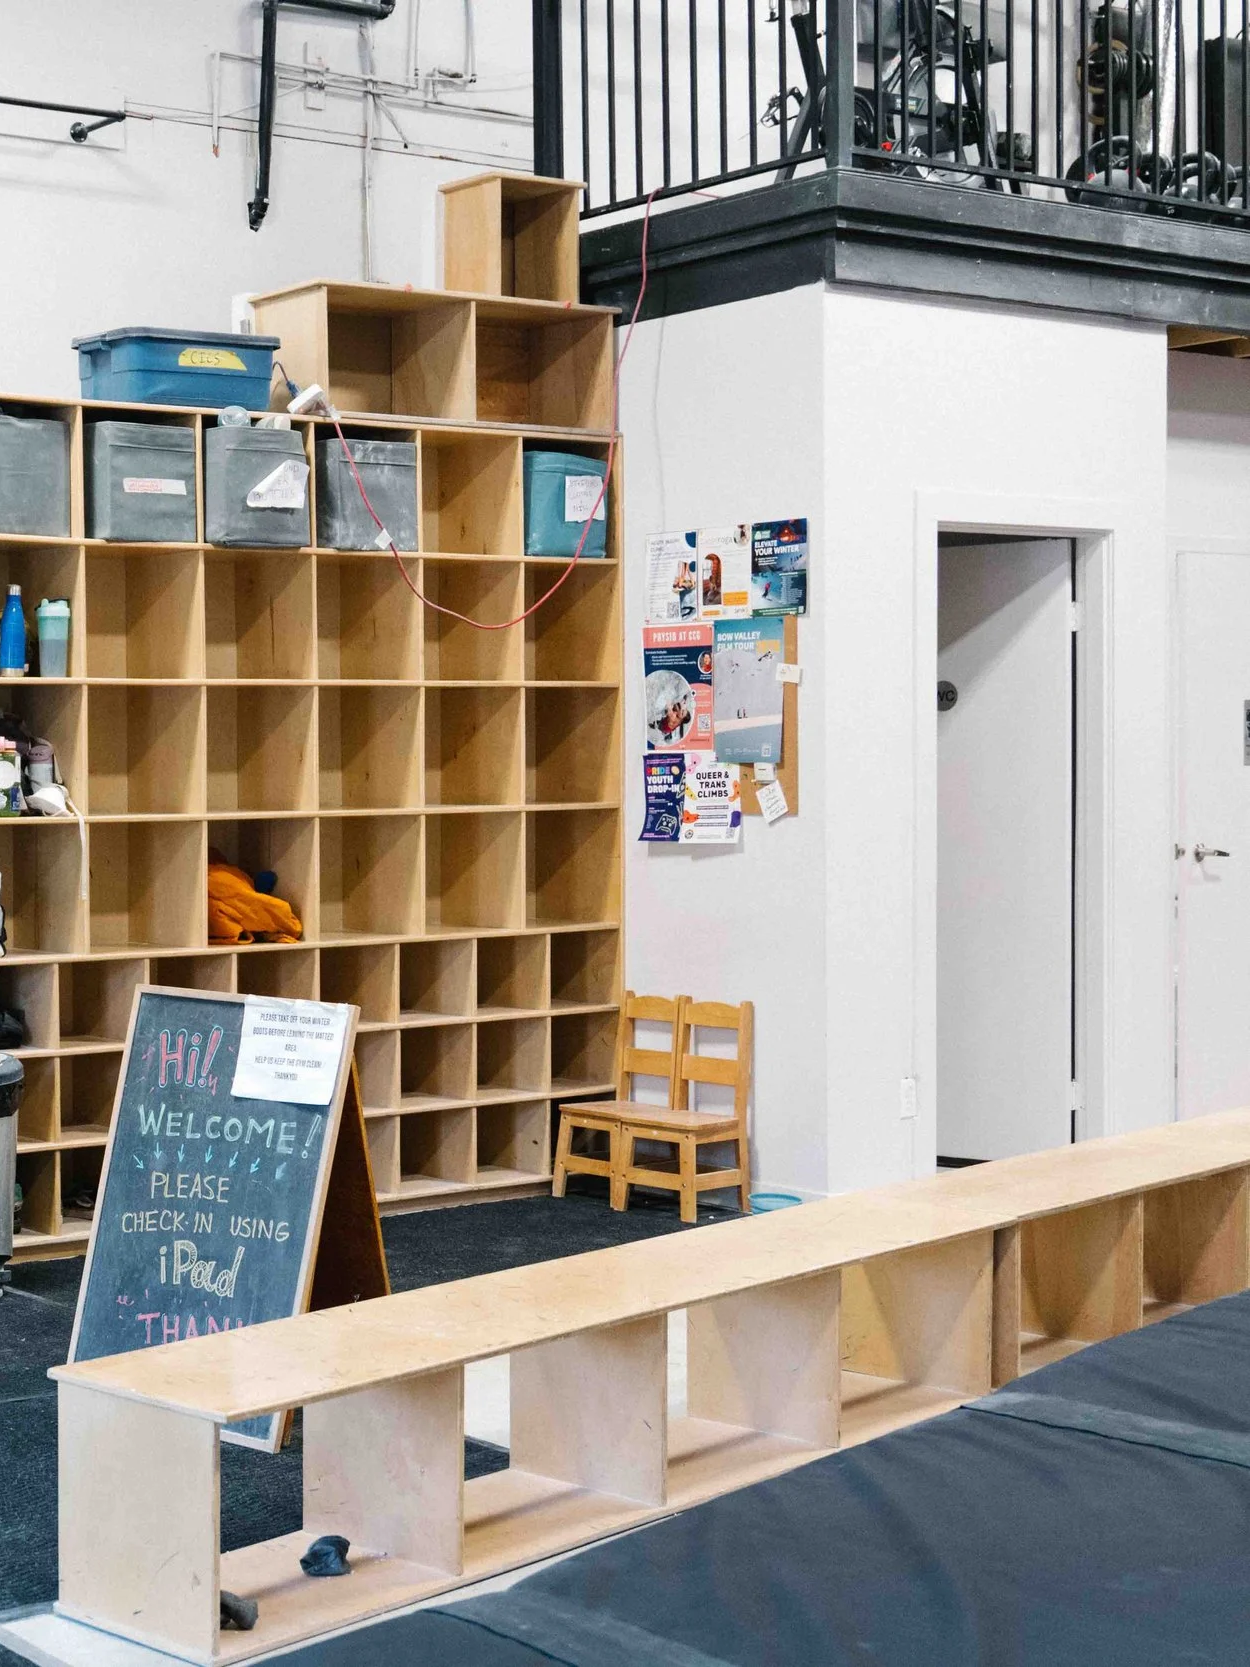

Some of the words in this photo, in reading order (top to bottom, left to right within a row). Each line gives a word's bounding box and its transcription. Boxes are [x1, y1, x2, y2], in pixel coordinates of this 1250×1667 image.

[754, 547, 773, 556] YOUR
[774, 544, 800, 554] WINTER
[652, 631, 676, 642] PHYSIO
[679, 631, 686, 641] AT
[717, 632, 733, 641] BOW
[734, 631, 761, 640] VALLEY
[717, 643, 733, 652] FILM
[734, 642, 755, 650] TOUR
[646, 775, 674, 784] YOUTH
[696, 772, 723, 780] QUEER
[697, 790, 729, 798] CLIMBS
[260, 1013, 277, 1022] PLEASE
[278, 1014, 289, 1023] TAKE
[290, 1015, 298, 1023] OFF
[299, 1016, 311, 1024] YOUR
[312, 1017, 331, 1026] WINTER
[253, 1027, 268, 1035] BOOTS
[268, 1028, 286, 1037] BEFORE
[159, 1026, 223, 1088] Hi!
[254, 1055, 267, 1064] HELP
[150, 1171, 230, 1204] PLEASE
[229, 1215, 290, 1242] USING
[158, 1240, 246, 1298] iPad
